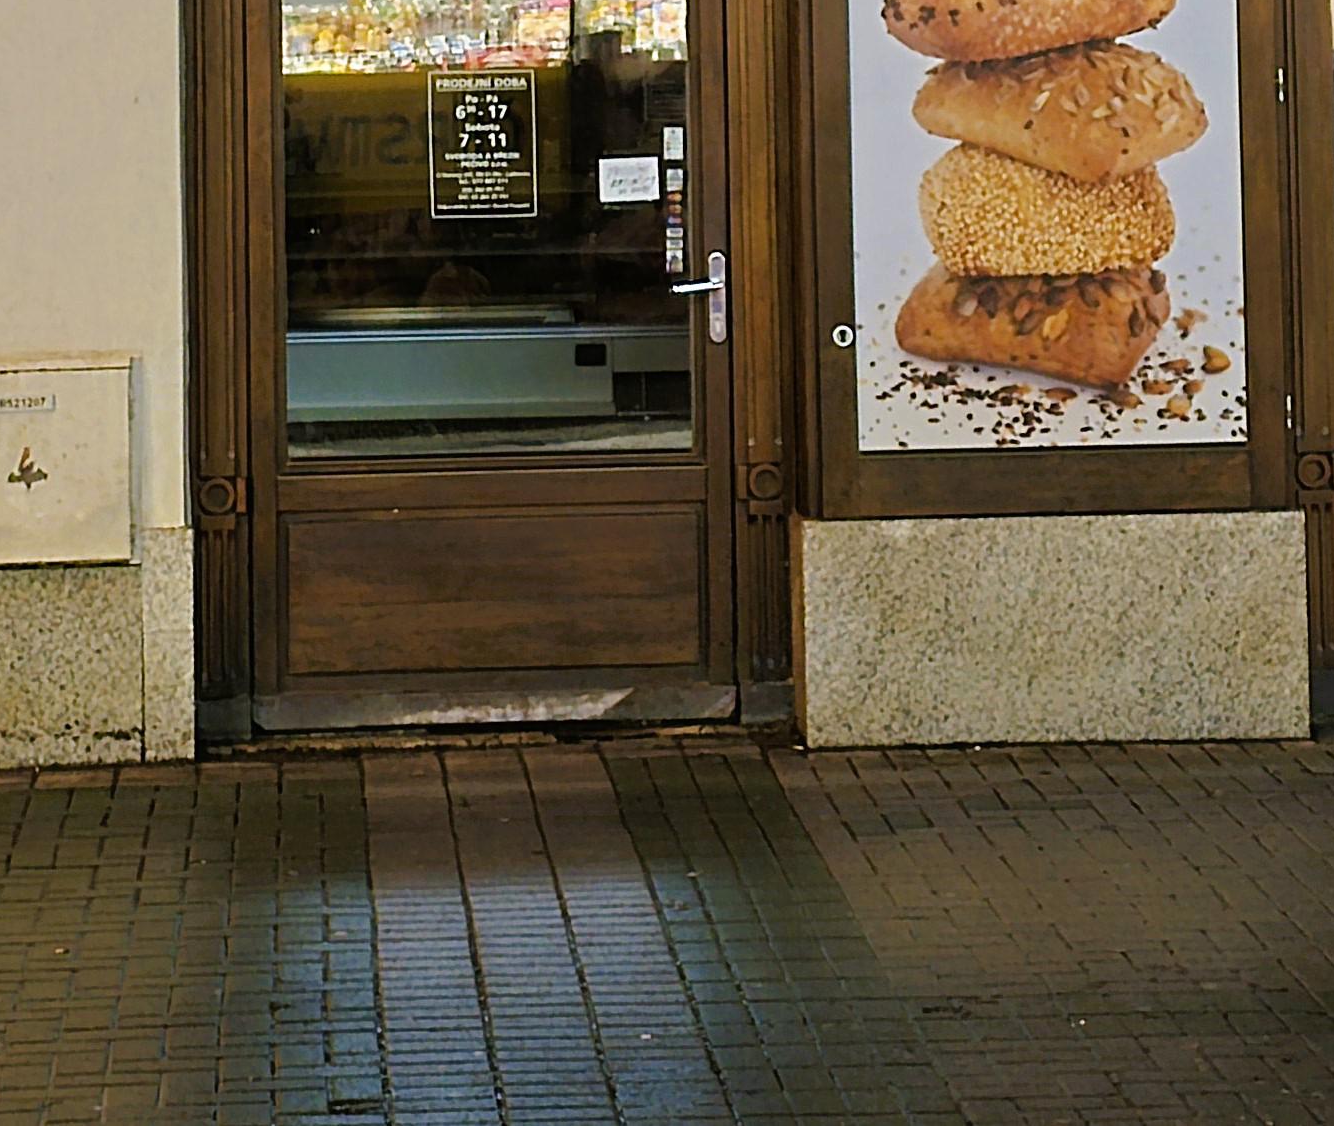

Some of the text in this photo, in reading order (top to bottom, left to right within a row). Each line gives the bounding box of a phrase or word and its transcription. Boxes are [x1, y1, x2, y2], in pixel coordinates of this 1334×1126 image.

[435, 76, 527, 88] PRODEJNÍ DOBA
[488, 104, 508, 119] 17
[458, 132, 470, 148] 7
[487, 132, 507, 147] 11
